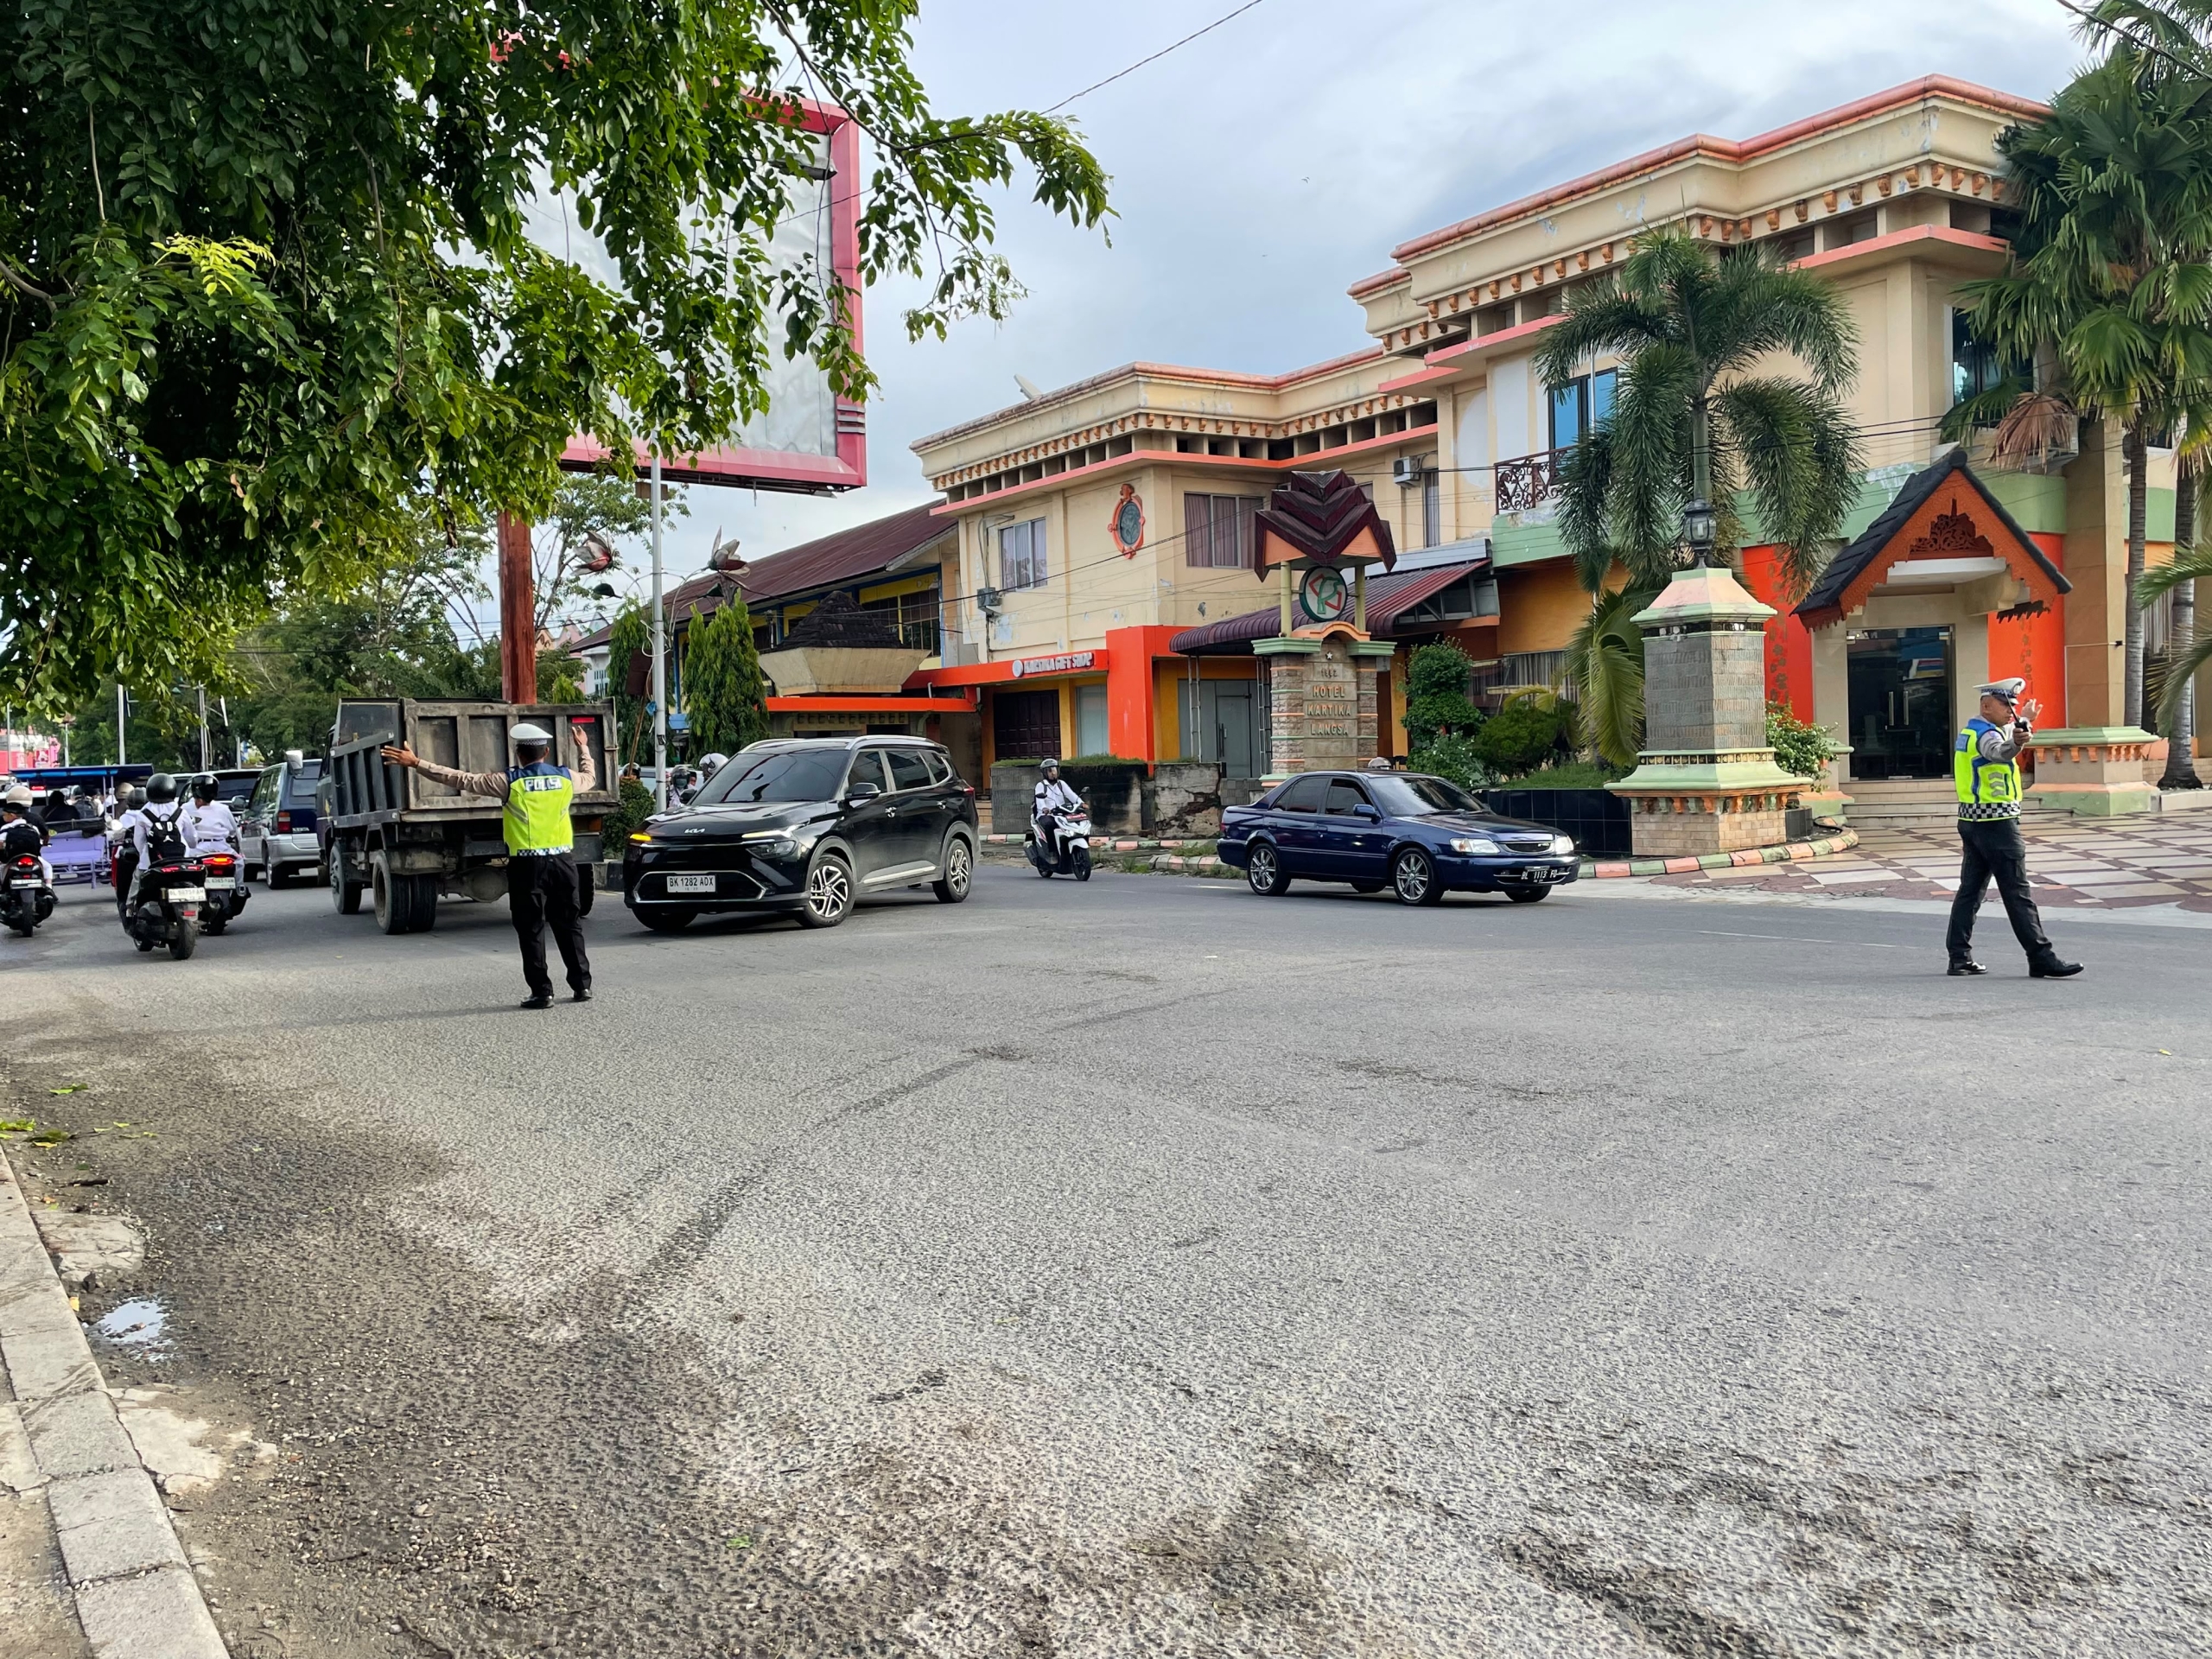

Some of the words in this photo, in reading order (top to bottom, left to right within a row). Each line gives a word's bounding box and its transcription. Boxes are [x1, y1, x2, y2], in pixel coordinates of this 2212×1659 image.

[1055, 656, 1072, 671] GIFT
[1072, 652, 1092, 668] SHOP
[1313, 685, 1345, 698] HOTEL
[1307, 704, 1351, 716] KARTIKA
[1310, 723, 1349, 735] LANGSA
[669, 877, 679, 887] BK
[680, 877, 698, 887] 1282
[699, 876, 714, 887] ADX
